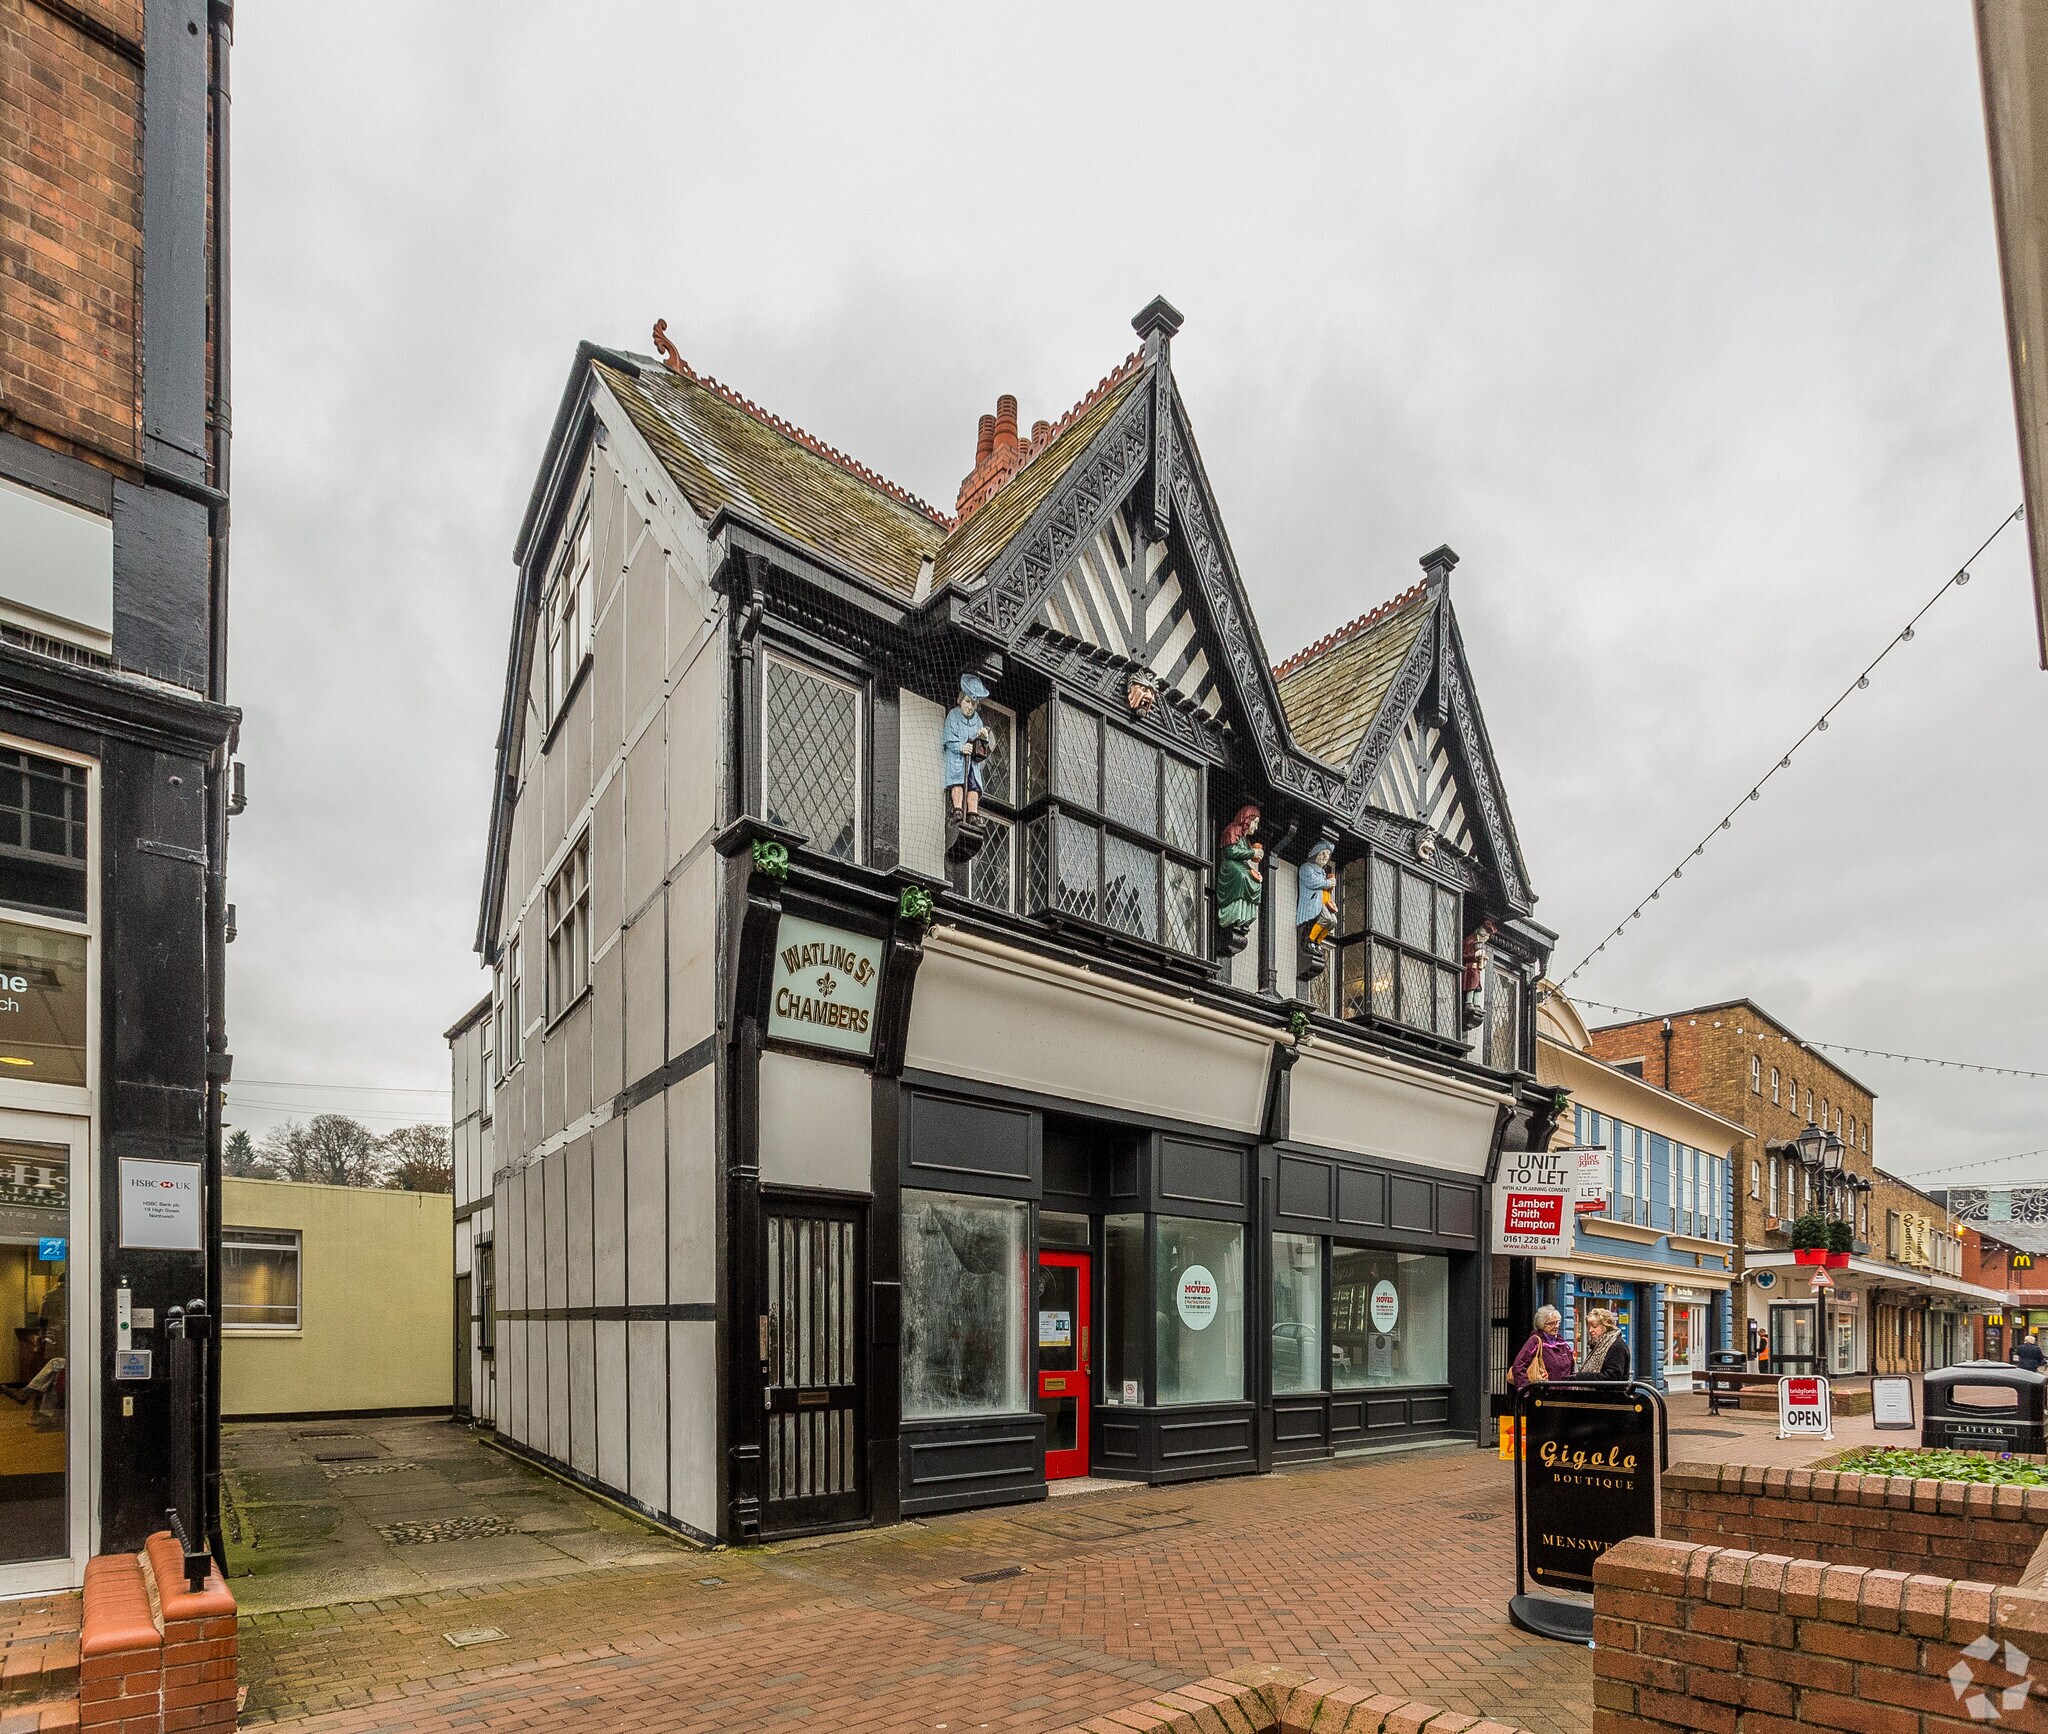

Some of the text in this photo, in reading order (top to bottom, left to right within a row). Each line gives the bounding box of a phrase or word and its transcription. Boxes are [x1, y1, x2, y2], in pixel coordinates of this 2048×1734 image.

[780, 942, 856, 977] WATLING
[775, 987, 870, 1034] CHAMBERS
[1517, 1155, 1561, 1170] UNIT
[1507, 1169, 1568, 1185] TO LET
[131, 1179, 191, 1190] HSBC UK
[1581, 1187, 1602, 1197] LET
[1512, 1198, 1555, 1209] Lambert
[1511, 1208, 1540, 1218] Smith
[1510, 1218, 1555, 1230] Hampton
[1503, 1235, 1560, 1245] 0161 228 6411
[1184, 1285, 1211, 1294] MOVED
[1581, 1278, 1624, 1297] Cheque Centre
[1787, 1410, 1822, 1427] OPEN
[1957, 1425, 2004, 1435] LITTER
[1540, 1440, 1638, 1470] Gigolo
[1553, 1473, 1634, 1490] BOUTIQUE
